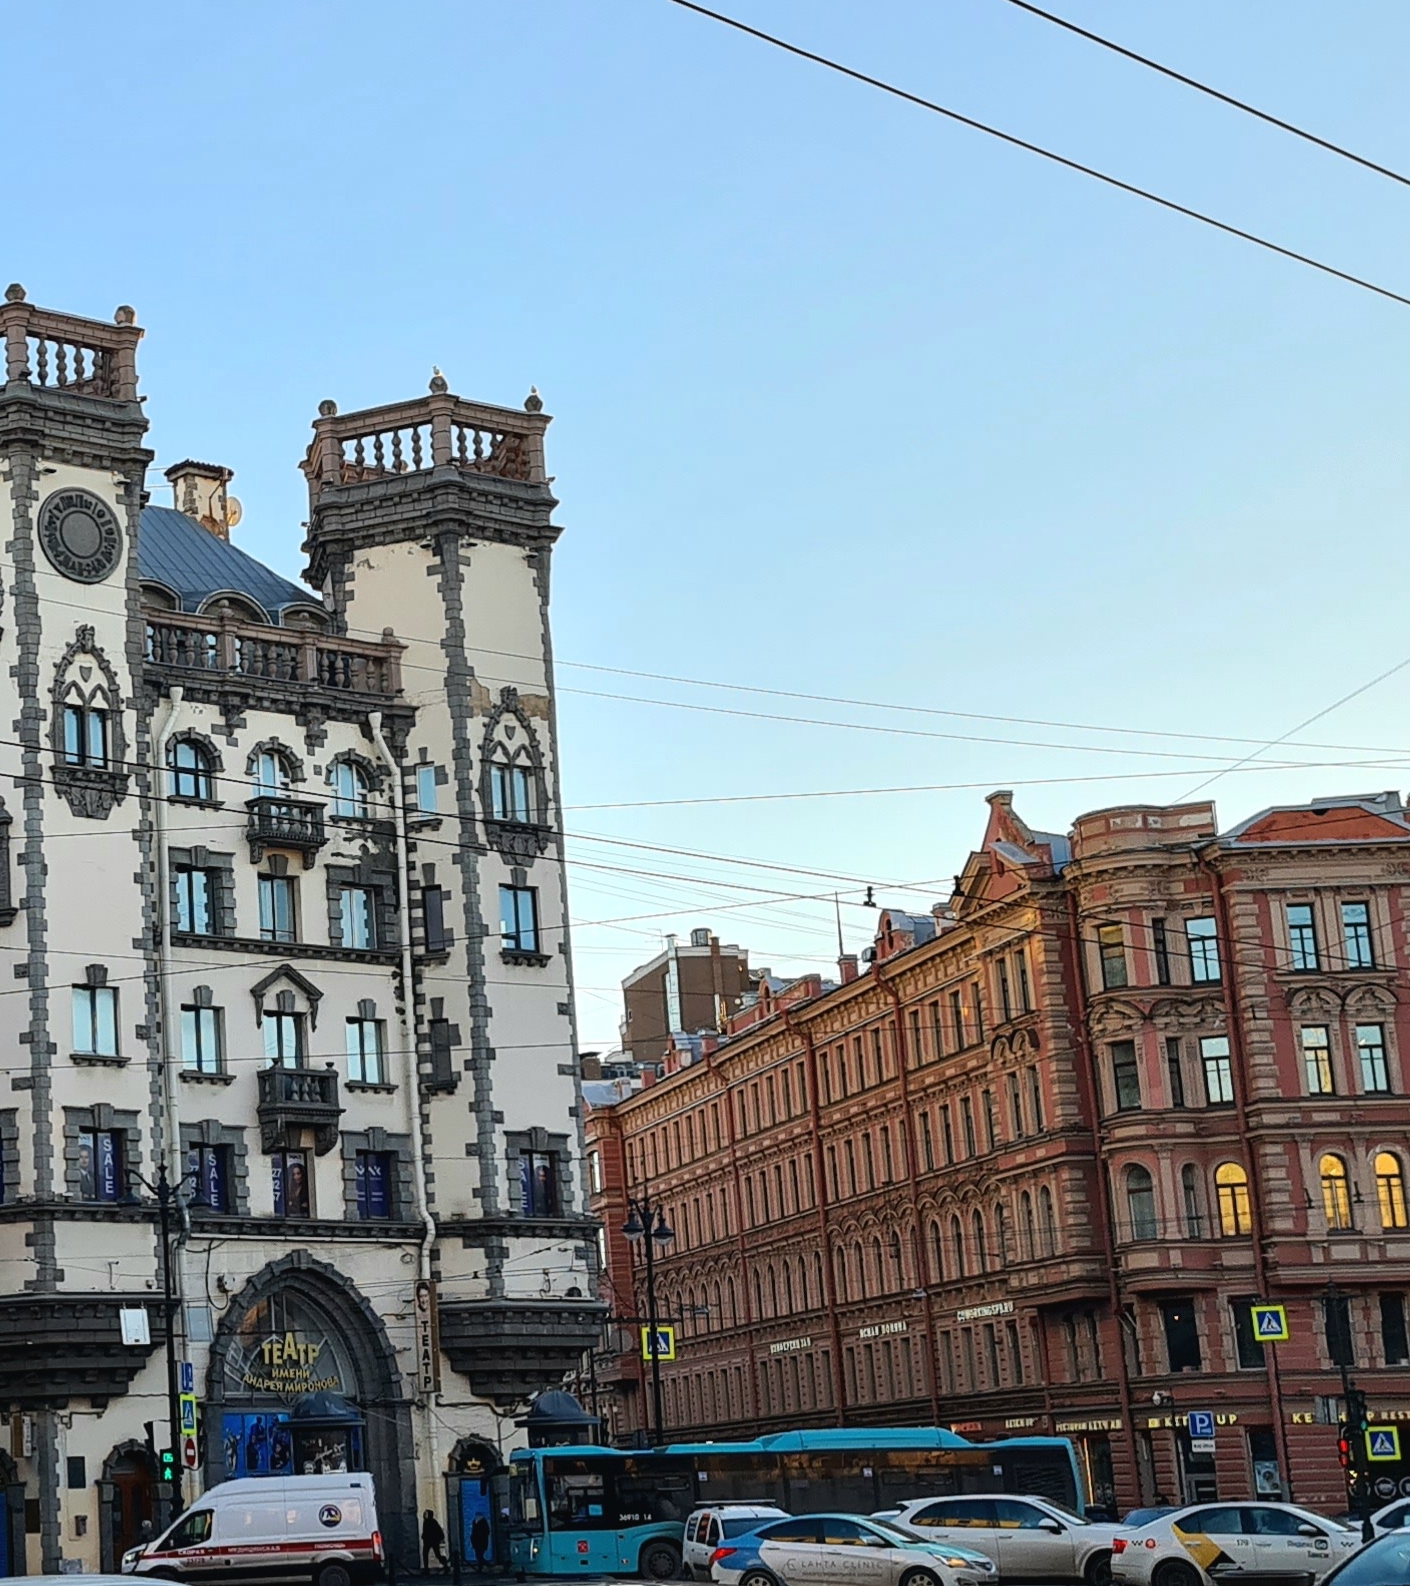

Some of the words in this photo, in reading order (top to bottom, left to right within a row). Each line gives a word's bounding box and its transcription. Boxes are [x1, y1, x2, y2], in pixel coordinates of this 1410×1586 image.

[103, 1139, 114, 1193] SALE
[209, 1154, 219, 1206] SALE
[261, 1332, 319, 1365] ТЕАТР
[421, 1321, 431, 1388] ТЕАТР
[243, 1374, 283, 1391] АНДРЕЯ
[285, 1376, 339, 1393] МИРОНОВА
[272, 1369, 310, 1379] ИМЕНИ
[1216, 1414, 1237, 1425] UP
